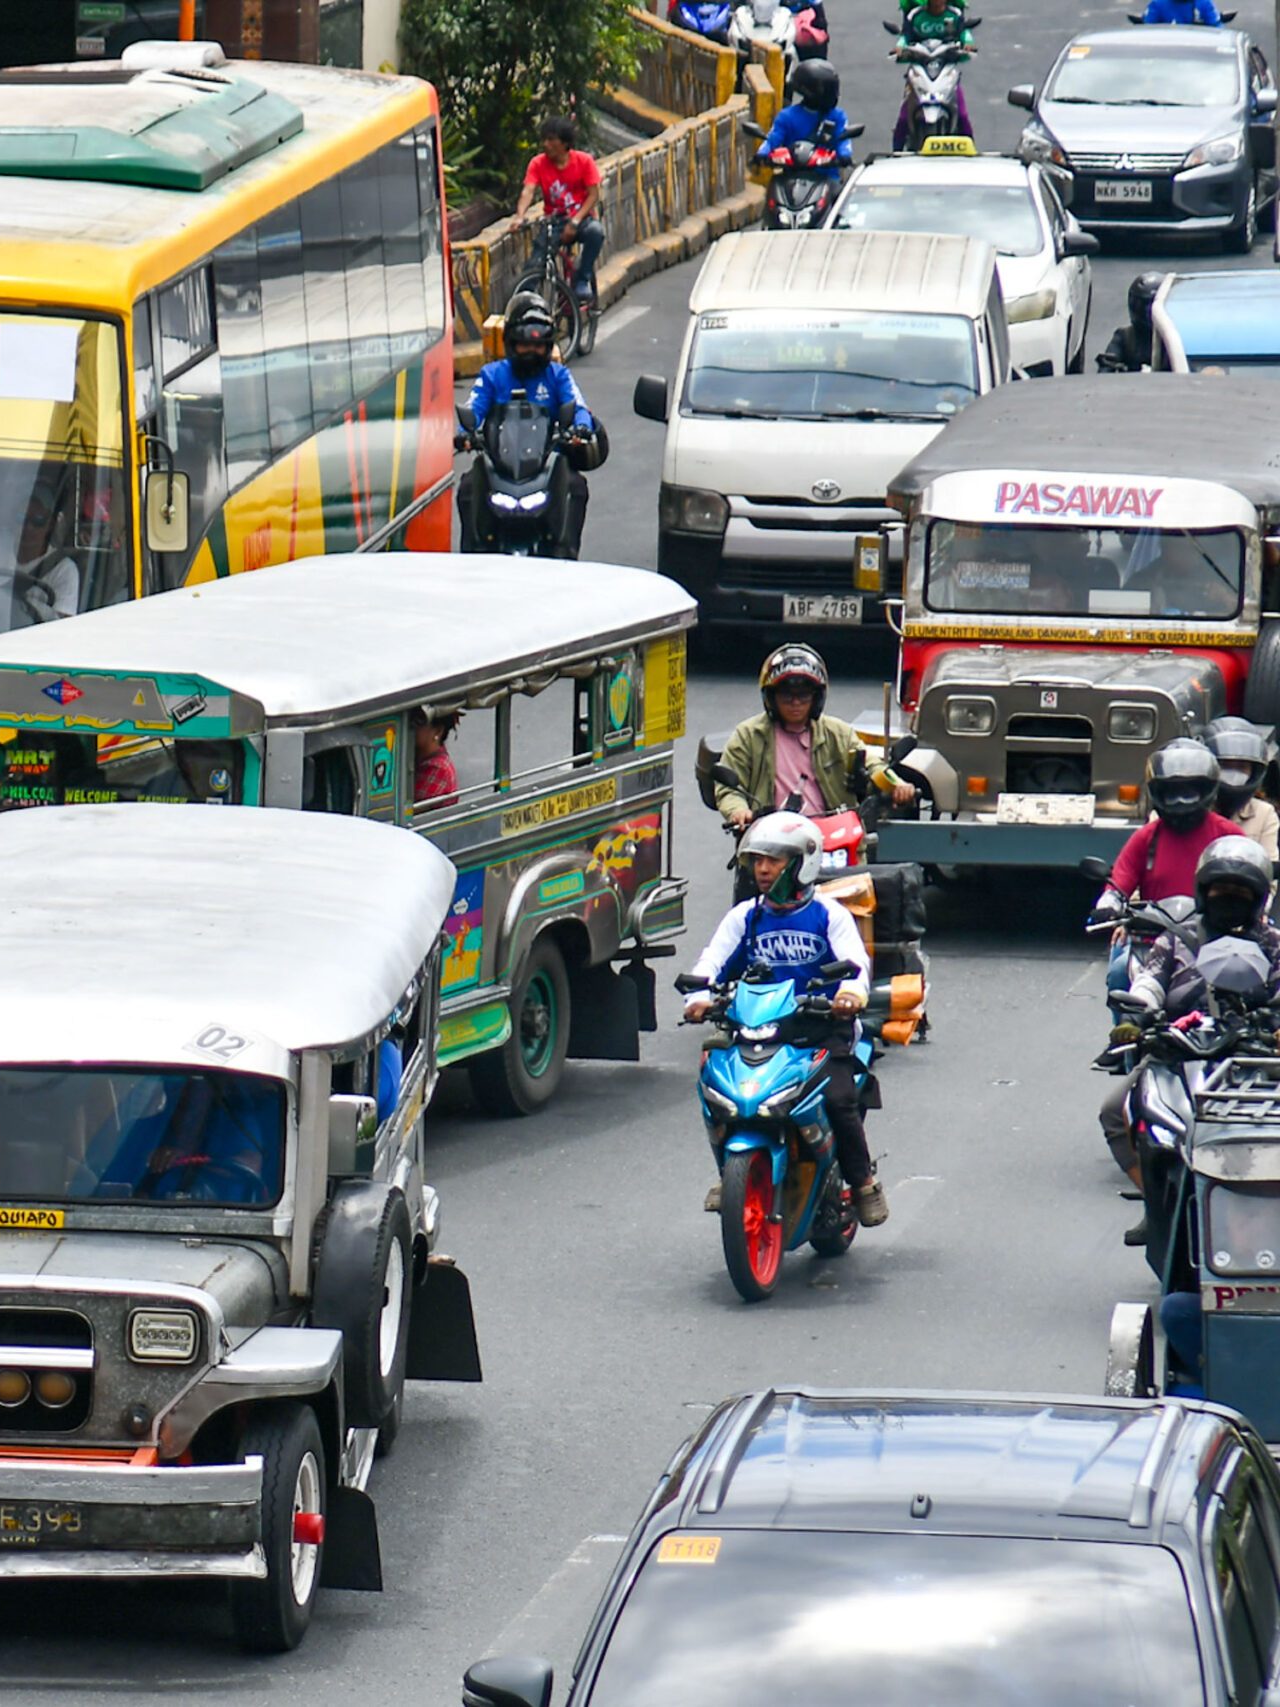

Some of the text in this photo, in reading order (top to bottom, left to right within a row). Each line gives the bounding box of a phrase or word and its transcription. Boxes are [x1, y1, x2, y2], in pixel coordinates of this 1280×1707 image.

[921, 22, 945, 34] Gra
[930, 141, 967, 151] DMC
[994, 481, 1164, 518] PASAWAY
[822, 602, 858, 618] 4789
[196, 1026, 246, 1058] 02
